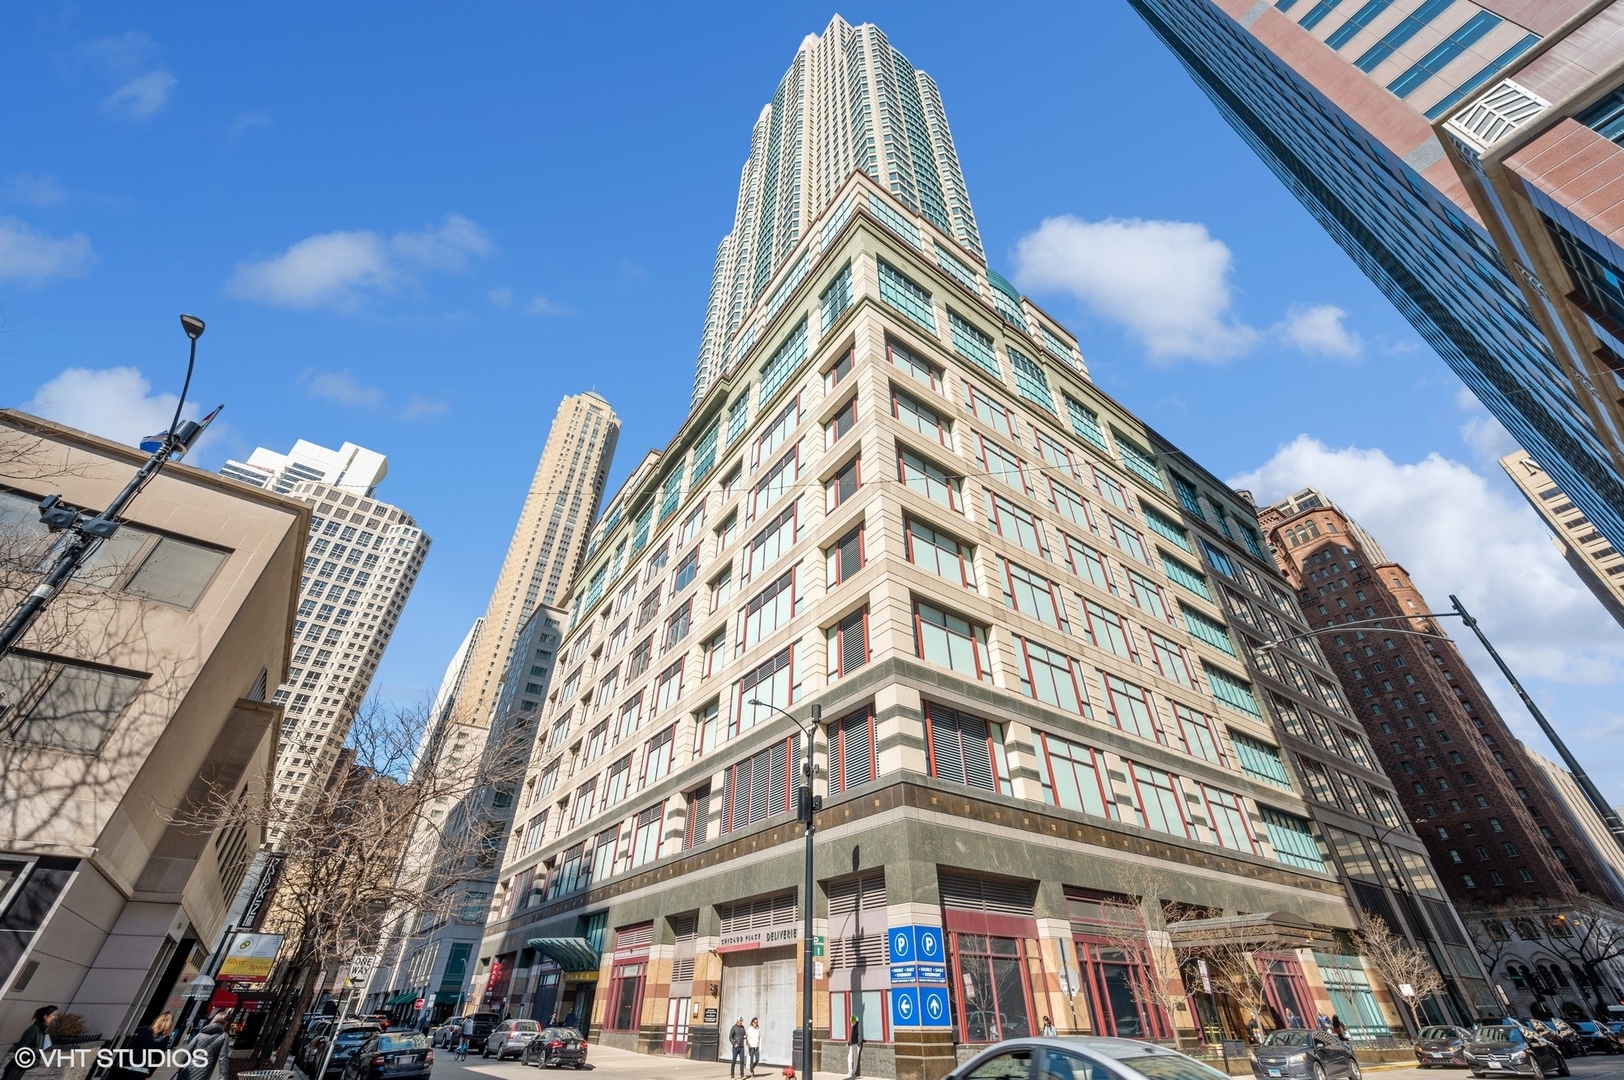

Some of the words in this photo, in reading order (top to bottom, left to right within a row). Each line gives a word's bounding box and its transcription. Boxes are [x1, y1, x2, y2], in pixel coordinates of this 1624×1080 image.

[246, 858, 281, 926] MAXINE
[766, 929, 797, 942] DELIVERIE
[898, 937, 906, 952] P
[925, 937, 933, 951] P
[355, 957, 373, 966] ONE
[351, 966, 369, 975] WAY
[490, 964, 498, 985] PARK
